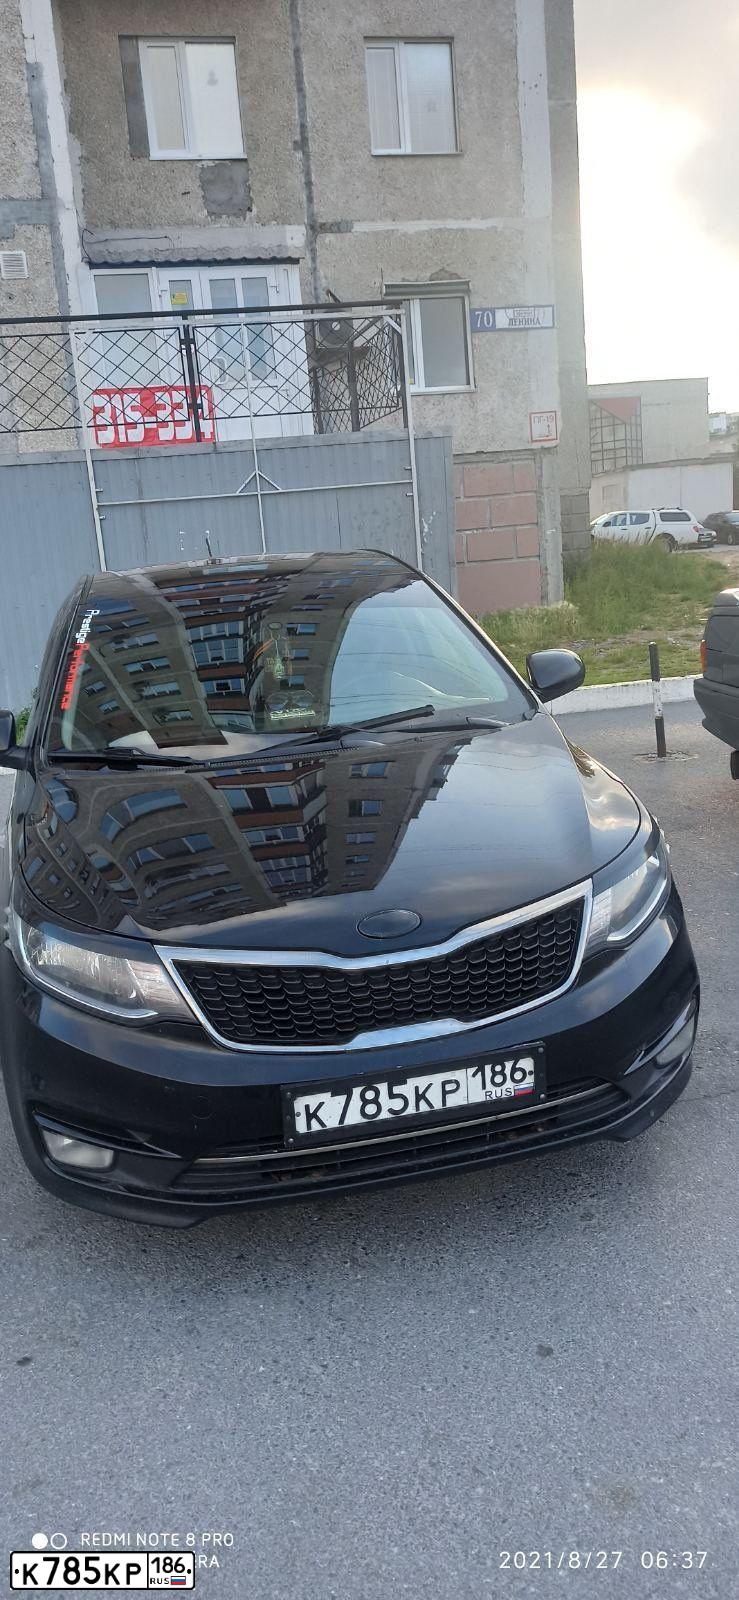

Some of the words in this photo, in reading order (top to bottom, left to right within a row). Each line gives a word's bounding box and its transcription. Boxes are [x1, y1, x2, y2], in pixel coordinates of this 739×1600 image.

[475, 311, 493, 328] 70
[508, 317, 542, 327] ЛЕНИНА
[93, 389, 214, 444] 315-334
[471, 1058, 528, 1091] 186
[484, 1087, 513, 1101] RUS
